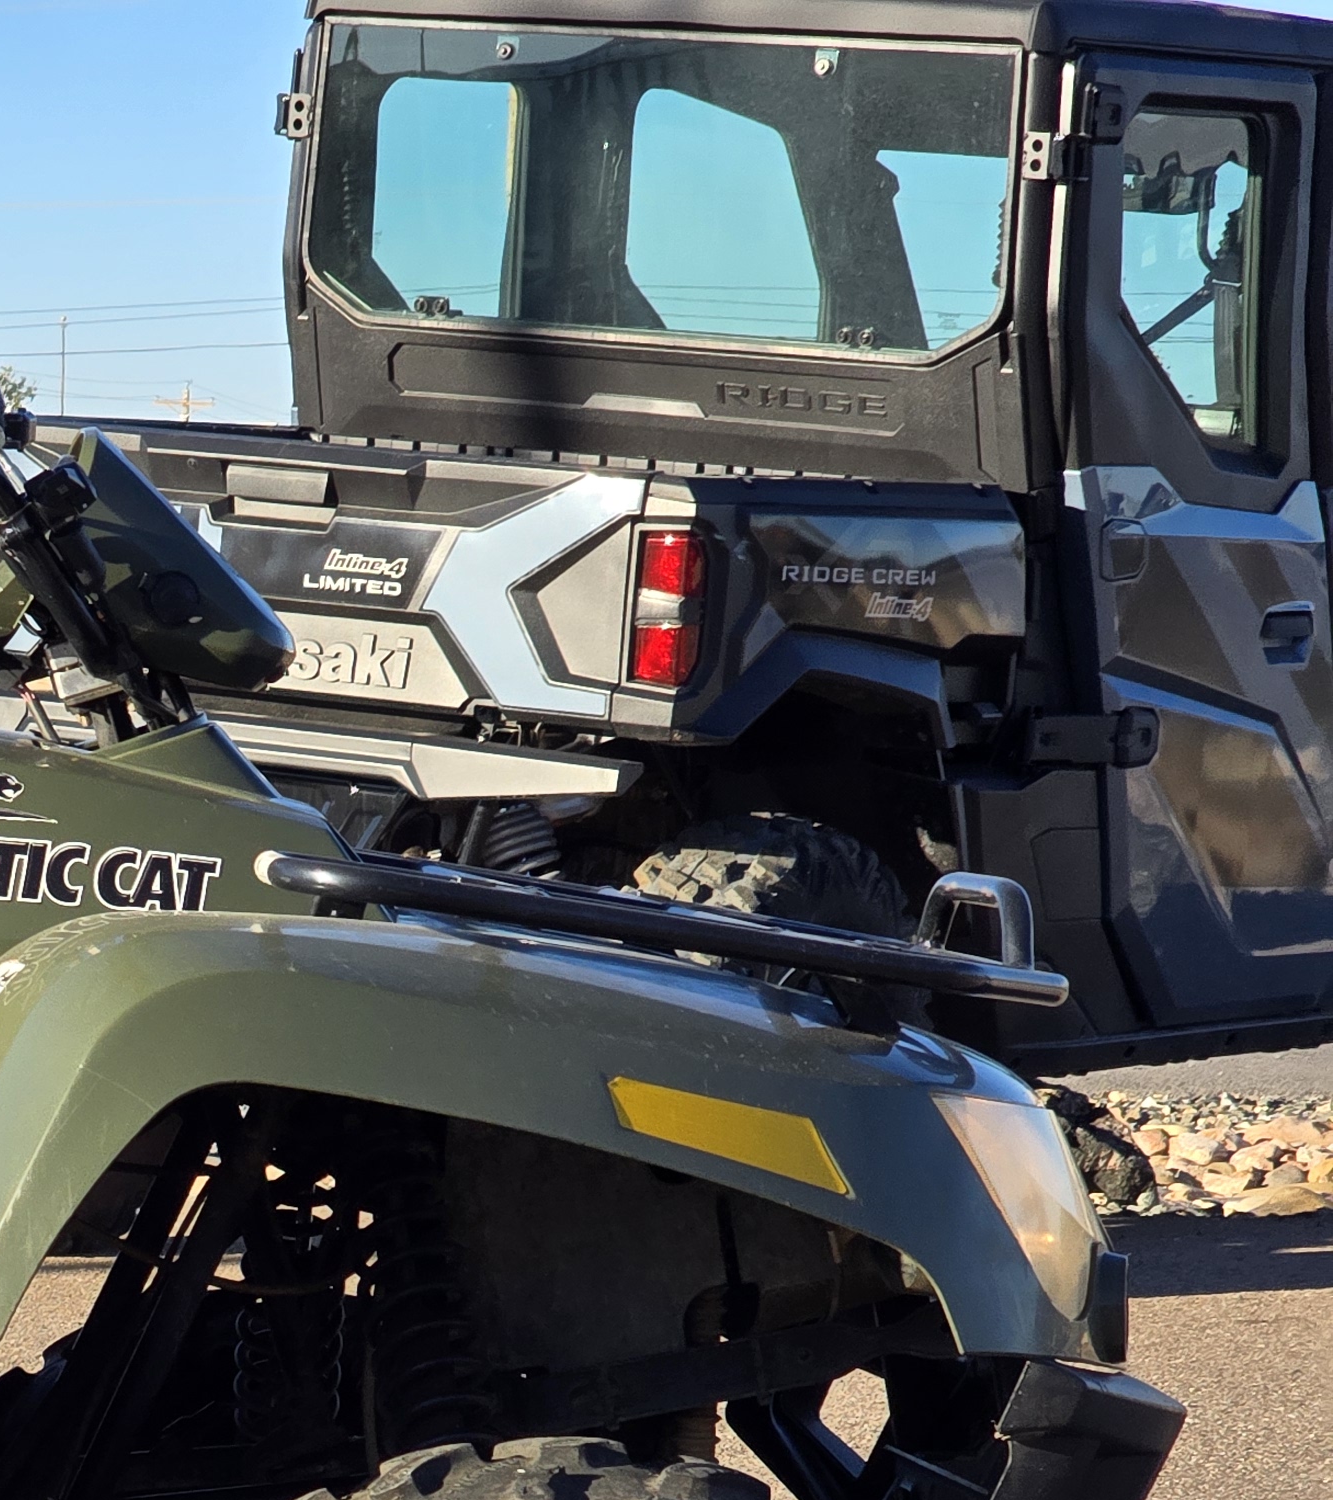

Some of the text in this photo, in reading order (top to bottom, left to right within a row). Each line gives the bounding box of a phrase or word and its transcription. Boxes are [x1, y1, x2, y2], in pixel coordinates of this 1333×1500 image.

[716, 381, 888, 417] RIDGE
[324, 548, 409, 579] Inline-4
[782, 565, 936, 586] RIDGE CREW
[302, 573, 403, 597] LIMITED
[286, 632, 414, 690] saki
[94, 847, 223, 912] CAT
